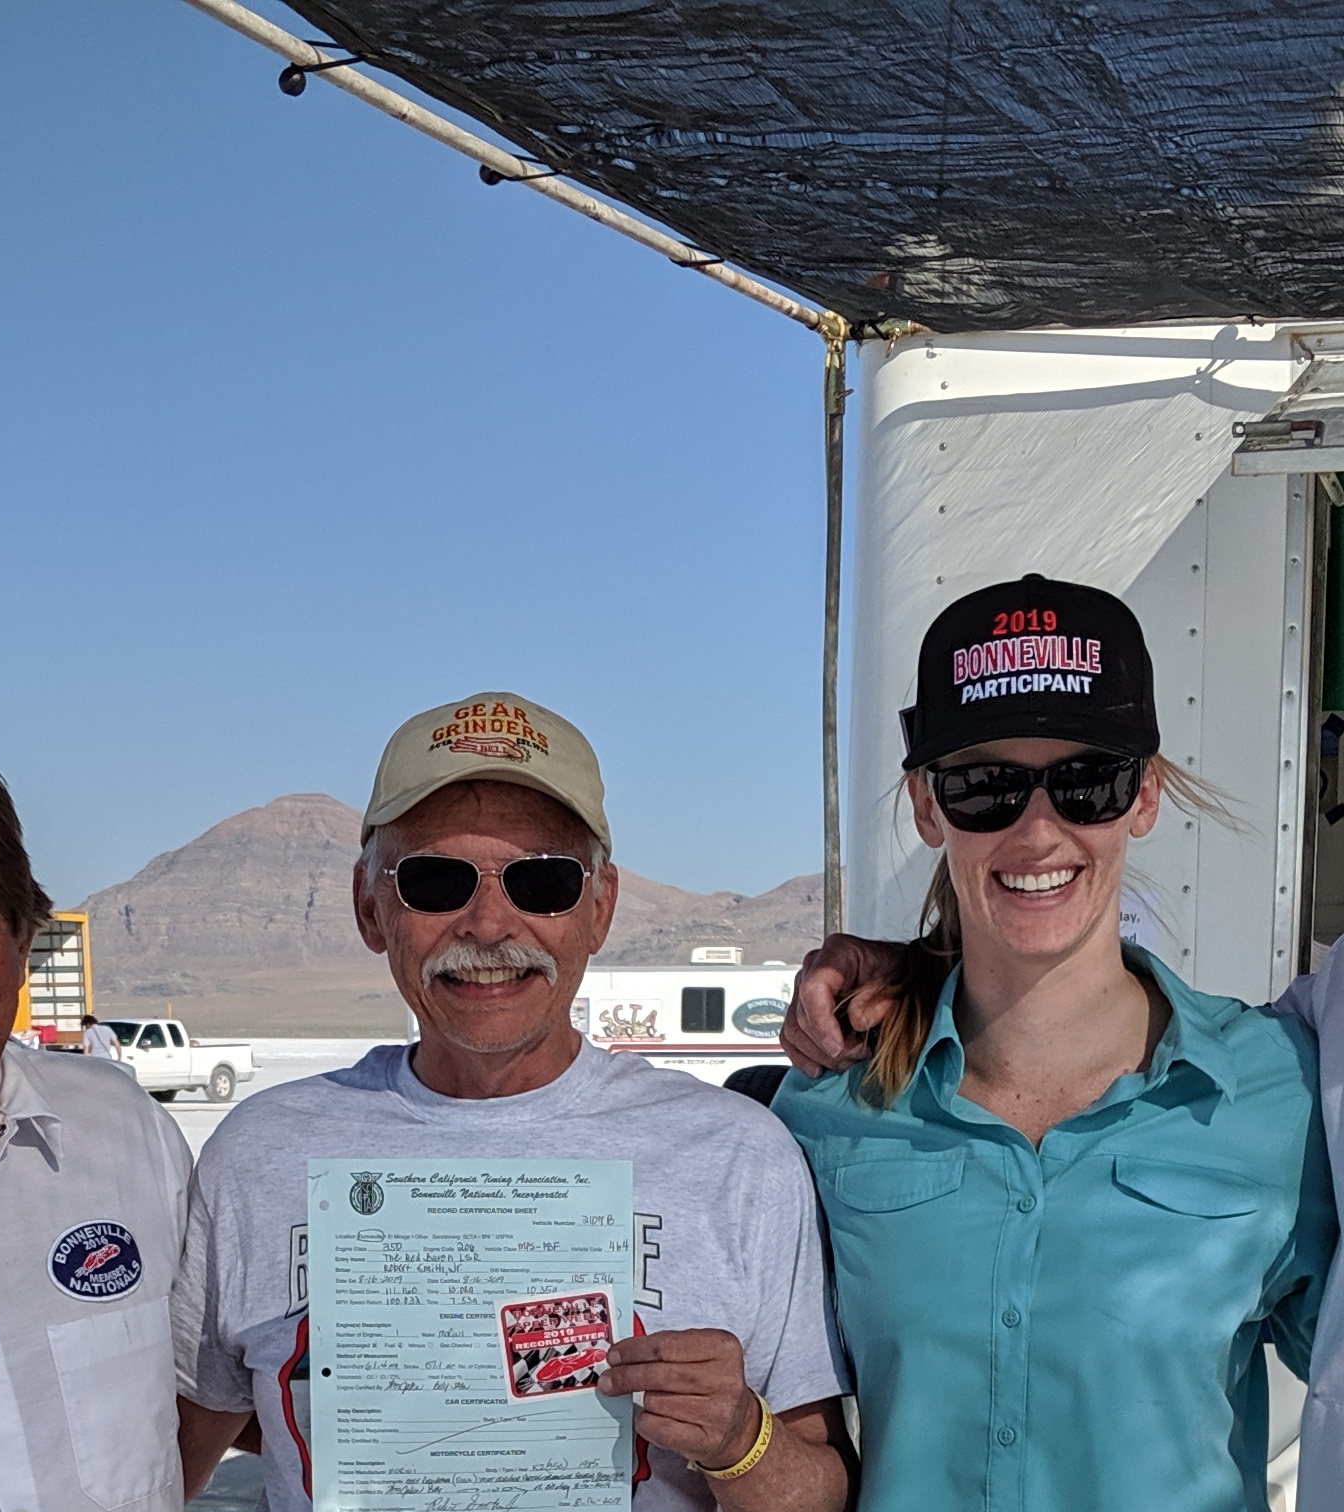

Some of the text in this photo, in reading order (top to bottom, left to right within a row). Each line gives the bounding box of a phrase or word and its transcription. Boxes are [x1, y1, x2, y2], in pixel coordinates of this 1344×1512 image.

[992, 608, 1057, 636] 2019
[953, 635, 1102, 685] BONNEVILLE
[960, 673, 1093, 706] PARTICIPANT
[453, 701, 531, 725] GEAR
[431, 718, 550, 750] GRINDERS
[385, 1172, 427, 1184] Southern
[429, 1172, 478, 1186] California
[481, 1173, 512, 1187] Timing
[574, 1174, 591, 1184] Inc.
[411, 1188, 457, 1199] Bonneville
[511, 1189, 569, 1201] Incorporated
[54, 1225, 133, 1264] BONNEVILLE
[82, 1235, 109, 1250] 2016
[69, 1260, 141, 1294] NATIONALS
[89, 1264, 128, 1282] MEMBER
[515, 1332, 605, 1350] RECORD SETTER
[543, 1328, 575, 1339] 2019
